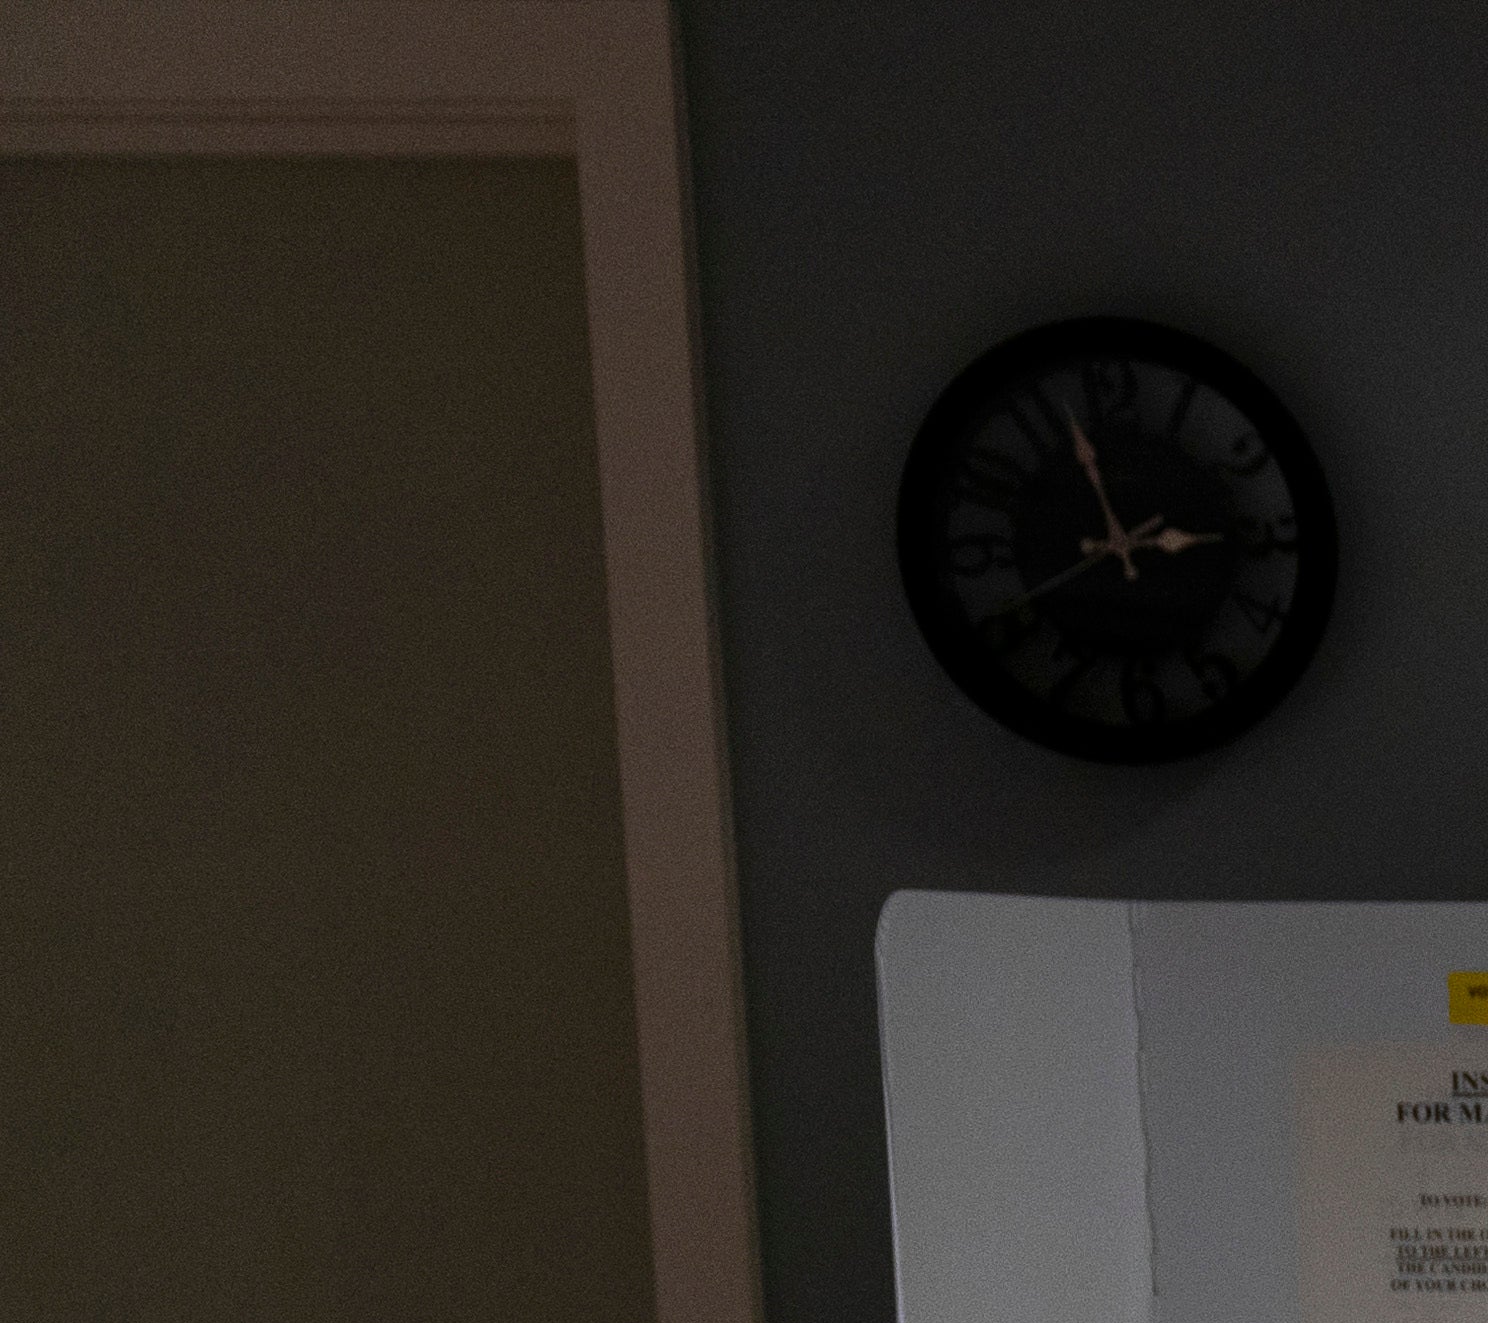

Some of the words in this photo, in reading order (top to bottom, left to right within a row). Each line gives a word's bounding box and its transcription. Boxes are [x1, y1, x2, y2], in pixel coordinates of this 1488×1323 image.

[1397, 1101, 1452, 1123] FOR
[1419, 1194, 1440, 1208] TO
[1390, 1228, 1421, 1241] FILL
[1426, 1228, 1443, 1241] IN
[1447, 1228, 1476, 1241] THE
[1397, 1245, 1418, 1260] TO
[1421, 1245, 1448, 1260] THE
[1452, 1245, 1488, 1260] LEFT
[1397, 1261, 1425, 1274] THE
[1389, 1279, 1411, 1292] OF
[1414, 1279, 1457, 1292] YOUR
